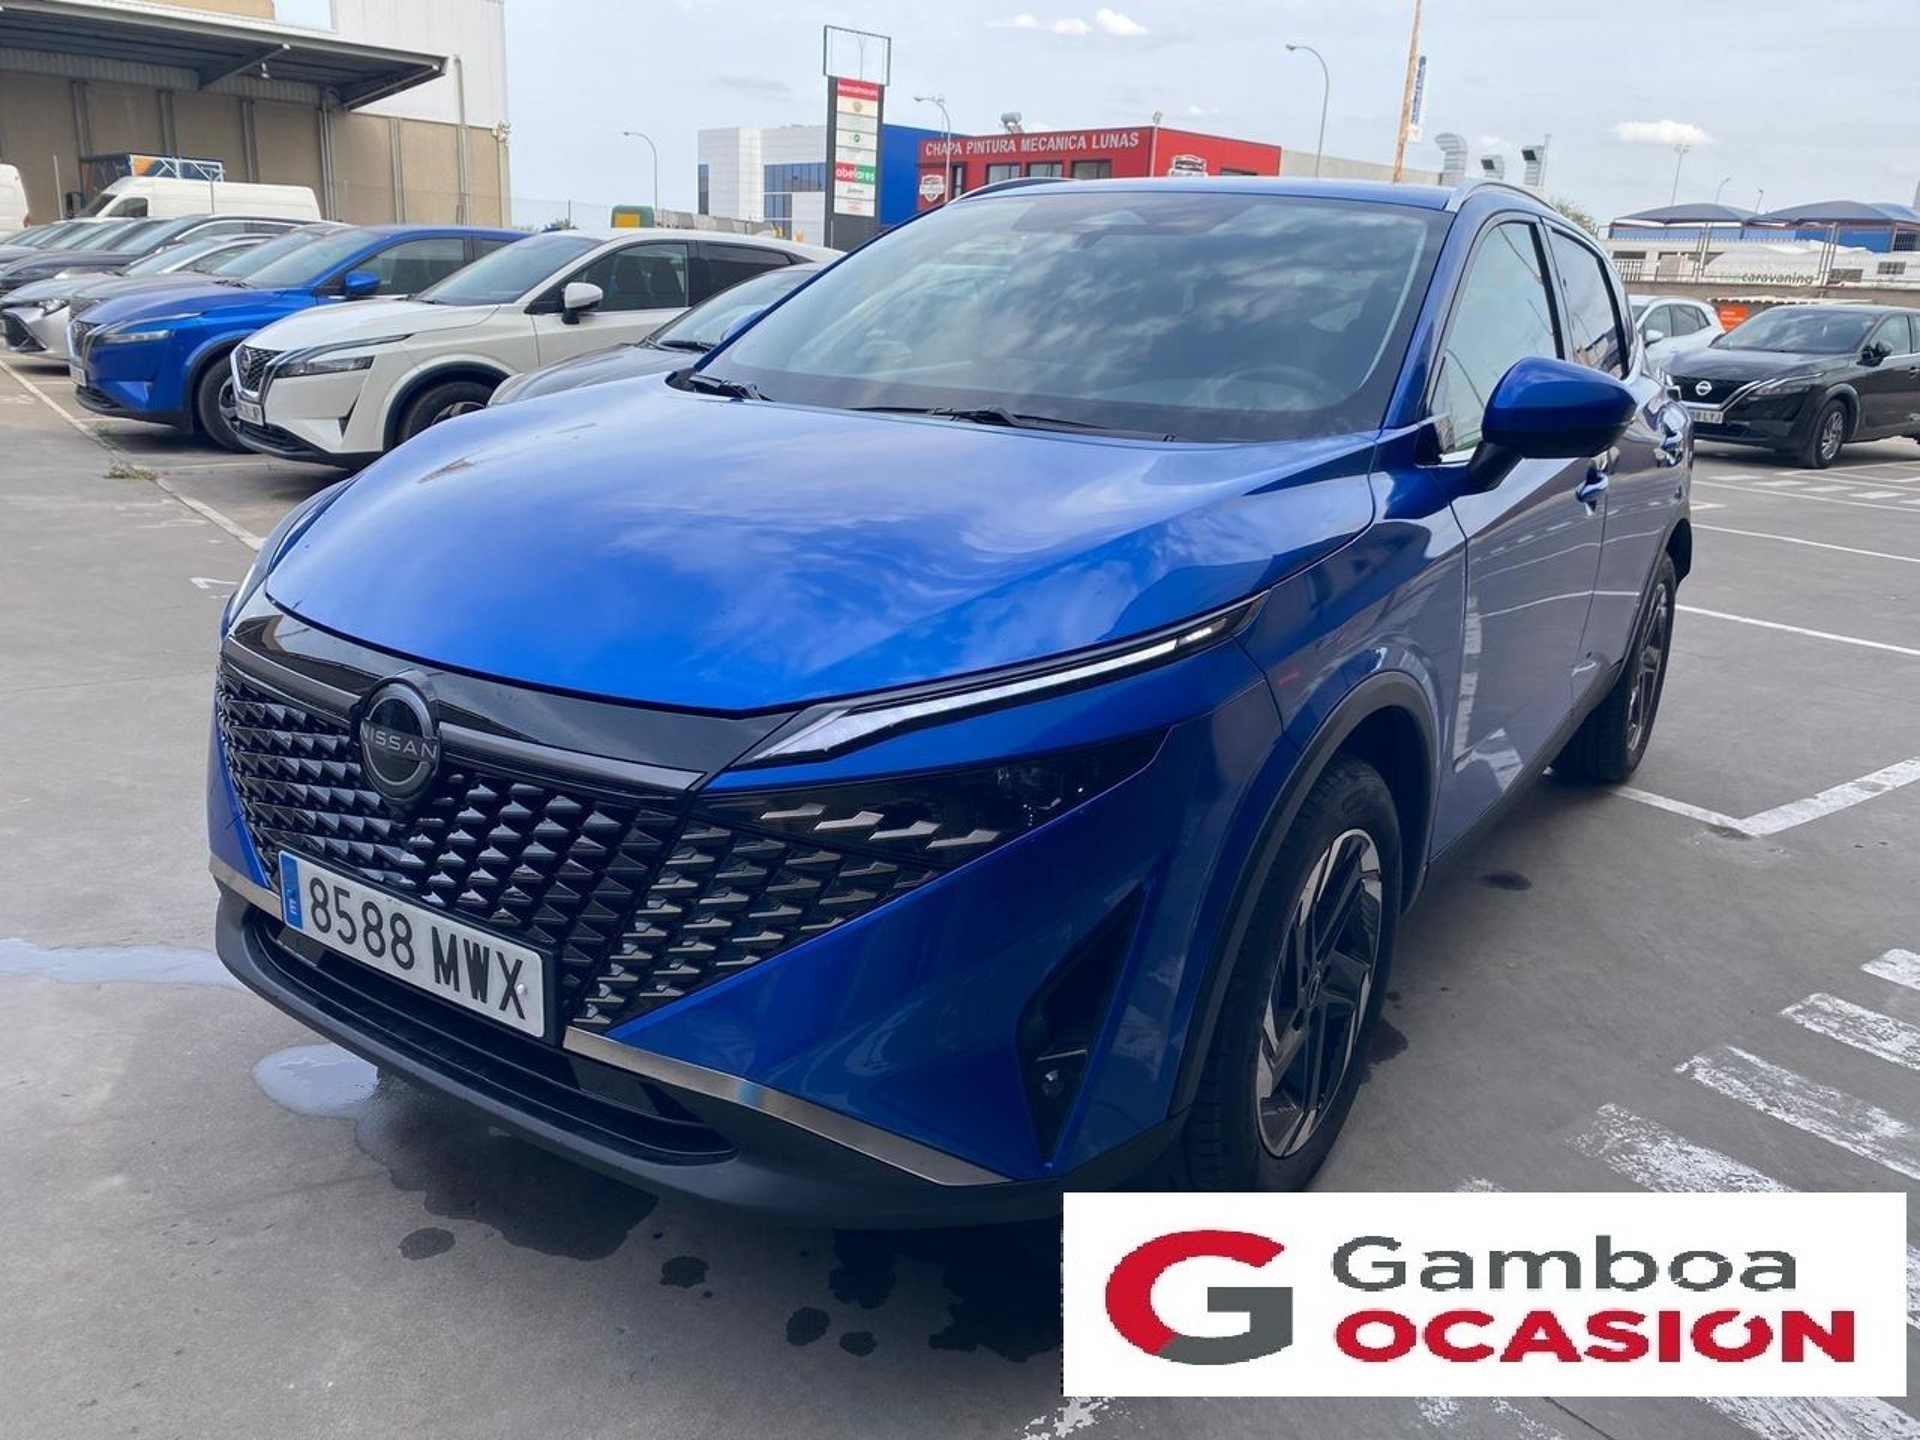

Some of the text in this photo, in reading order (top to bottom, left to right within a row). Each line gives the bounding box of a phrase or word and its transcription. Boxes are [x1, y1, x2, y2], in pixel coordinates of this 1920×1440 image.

[926, 131, 1139, 156] CHAPA PINTURA MECANICA LUNAS
[360, 721, 438, 760] NISSAN
[309, 877, 526, 1020] 8588 MWX
